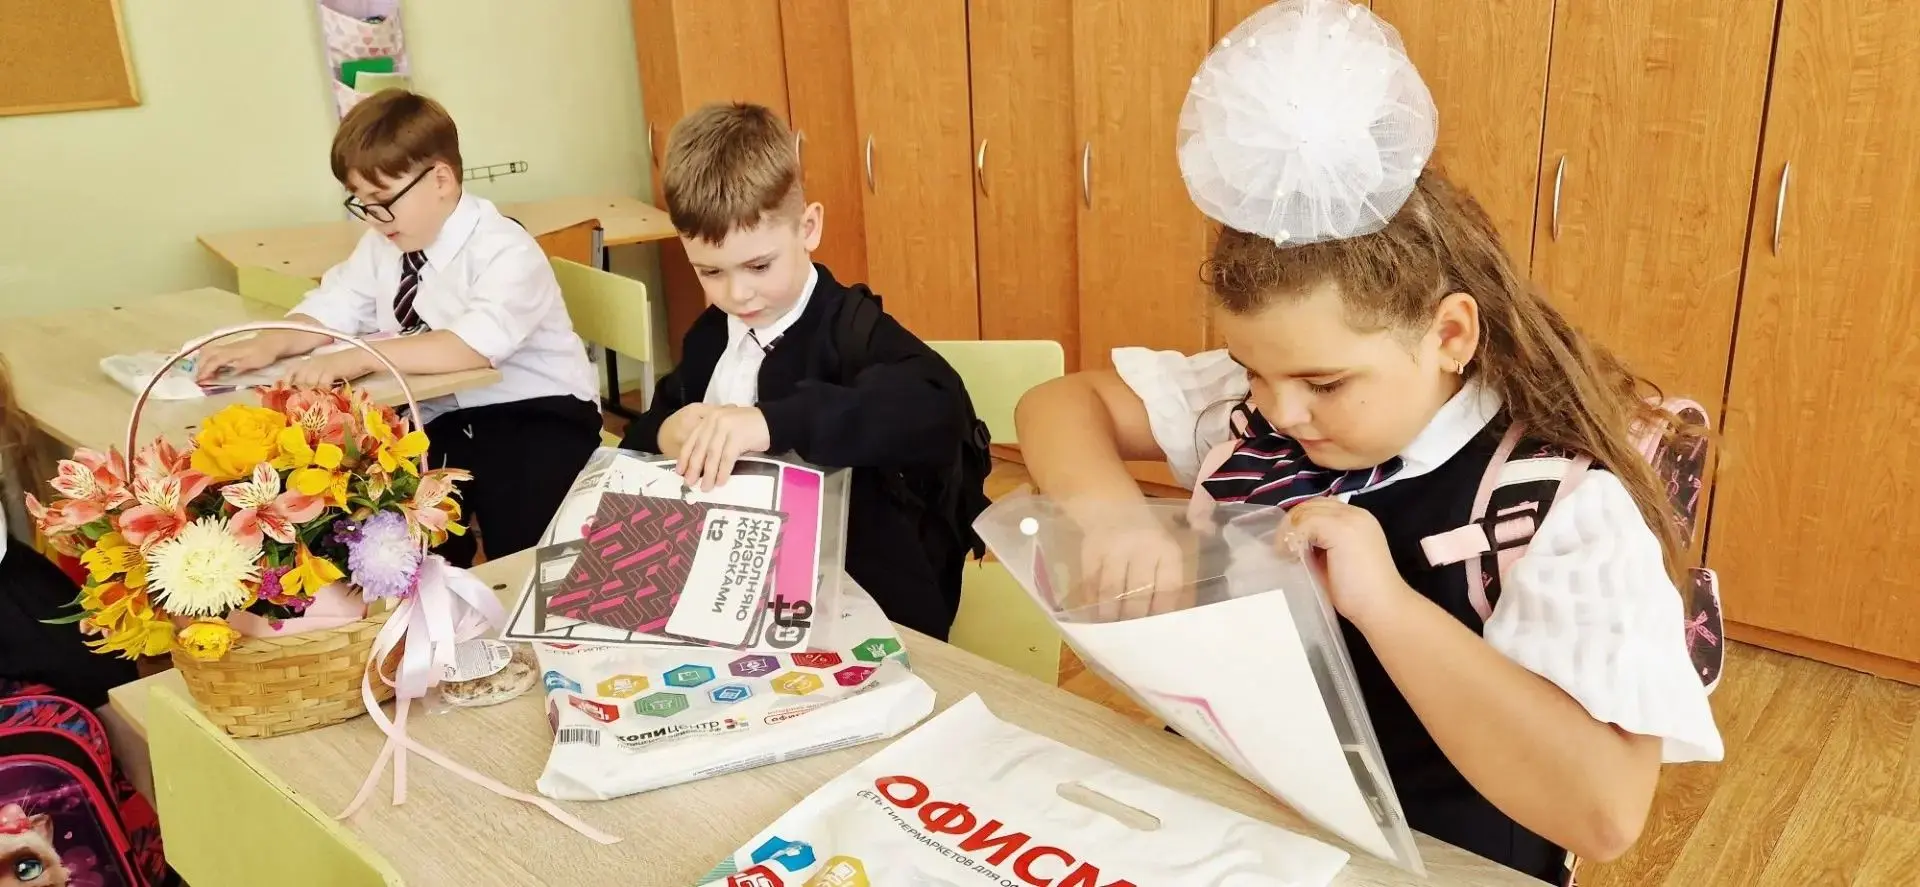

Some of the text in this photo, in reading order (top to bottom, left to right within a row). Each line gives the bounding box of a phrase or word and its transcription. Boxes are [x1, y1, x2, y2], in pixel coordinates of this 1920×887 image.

[712, 517, 749, 613] КРАСКАМИ
[735, 519, 762, 586] ЖИЗНЬ
[736, 520, 774, 621] НАПОЛНЯЮ
[856, 789, 883, 806] СЕТЬ
[882, 805, 975, 868] ГИПЕРМАРКЕТОВ
[972, 865, 1001, 881] ДЛЯ
